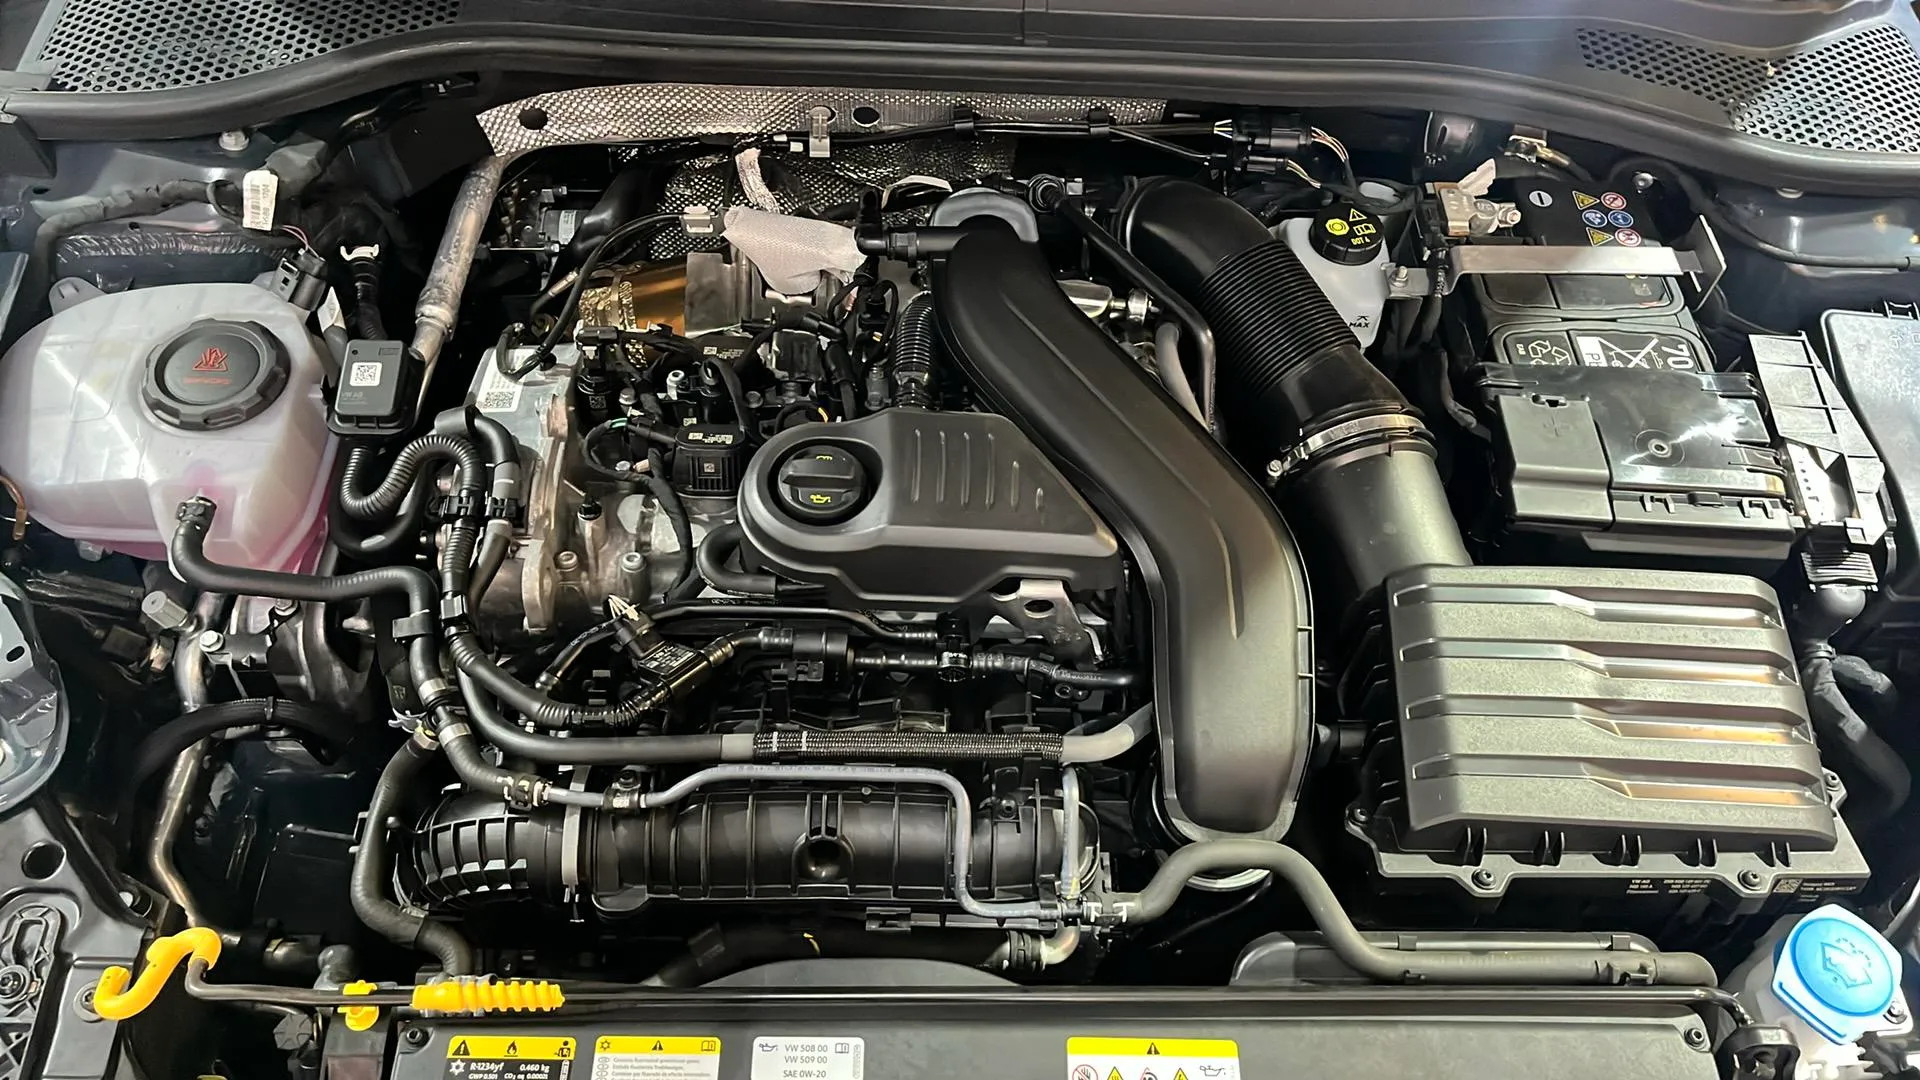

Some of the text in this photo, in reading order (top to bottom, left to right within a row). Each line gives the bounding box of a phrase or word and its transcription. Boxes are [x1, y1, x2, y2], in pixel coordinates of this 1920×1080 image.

[1351, 237, 1364, 245] DOT
[1661, 344, 1694, 370] 70
[784, 1044, 829, 1053] VW 508 00
[799, 1056, 815, 1064] 509
[816, 1056, 828, 1064] 00
[469, 1062, 505, 1073] R-1234yf
[519, 1063, 540, 1072] 0.460
[540, 1063, 551, 1073] kg
[783, 1070, 827, 1078] SAE 0W-20
